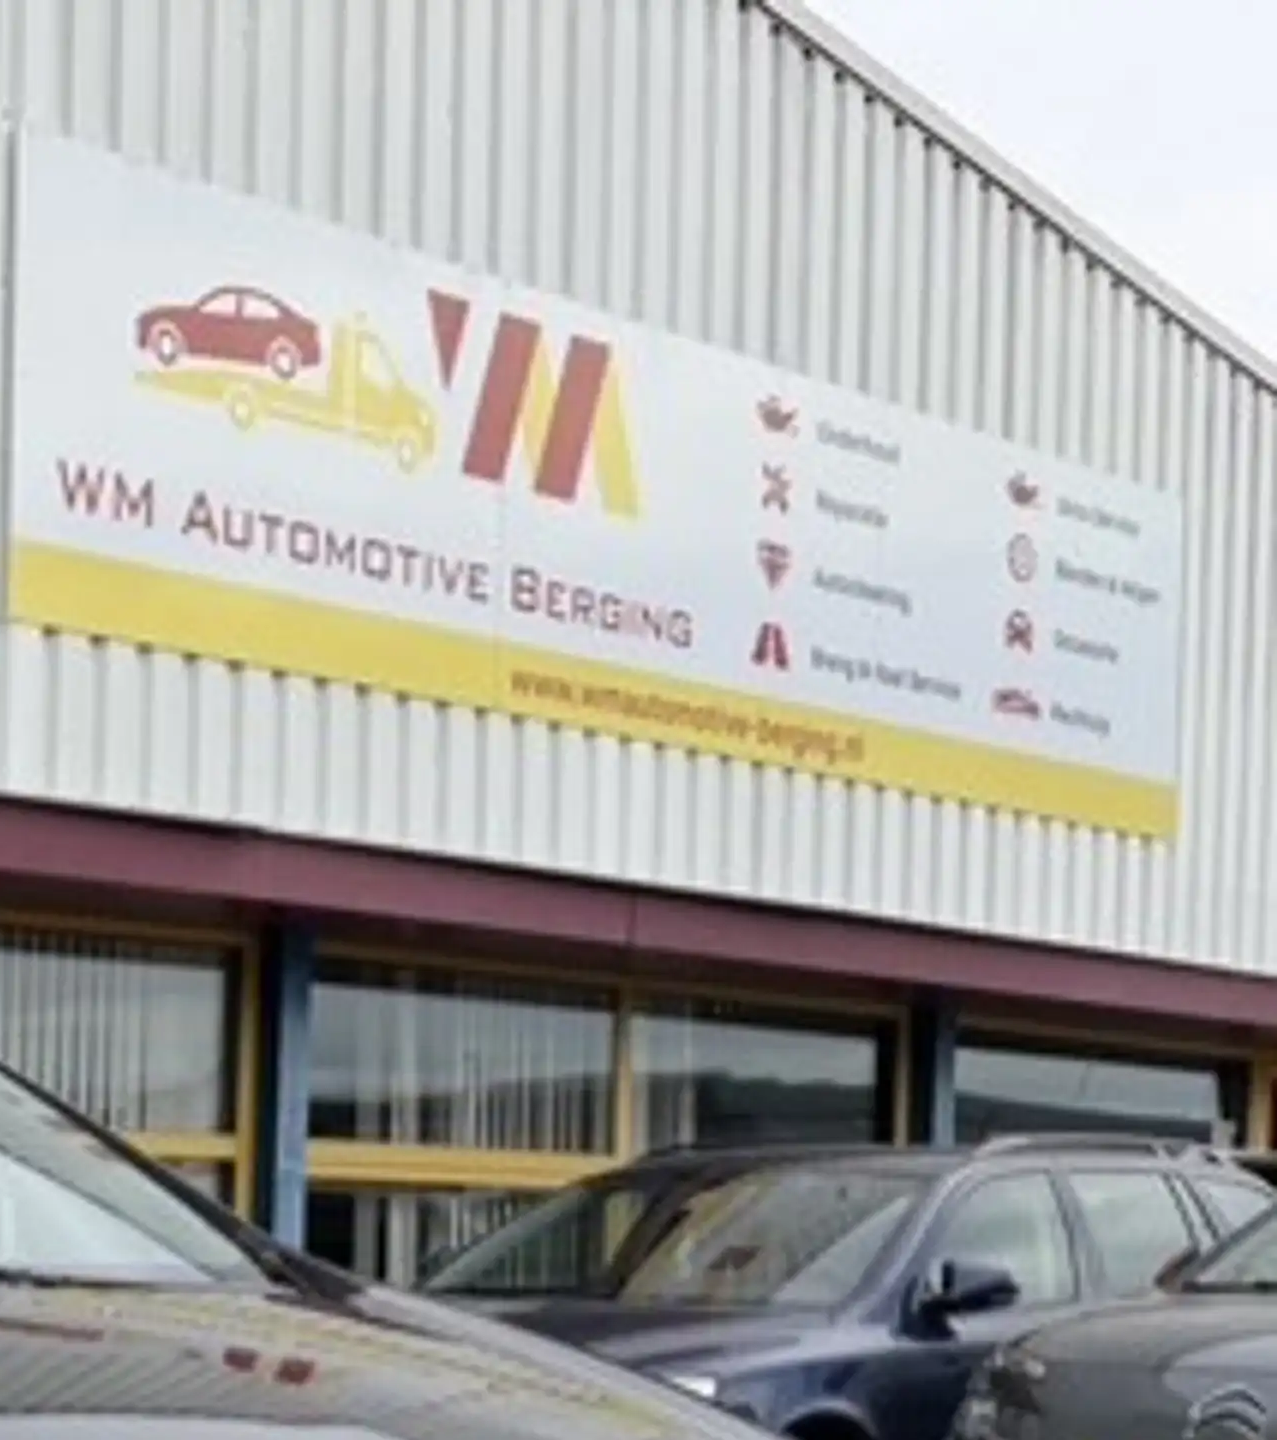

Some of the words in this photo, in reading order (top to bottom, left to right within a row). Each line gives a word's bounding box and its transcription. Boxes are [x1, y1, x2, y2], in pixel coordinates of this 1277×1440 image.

[56, 459, 155, 528] WM
[181, 491, 489, 602] AUTOMOTIVE
[510, 566, 694, 649] BERGING
